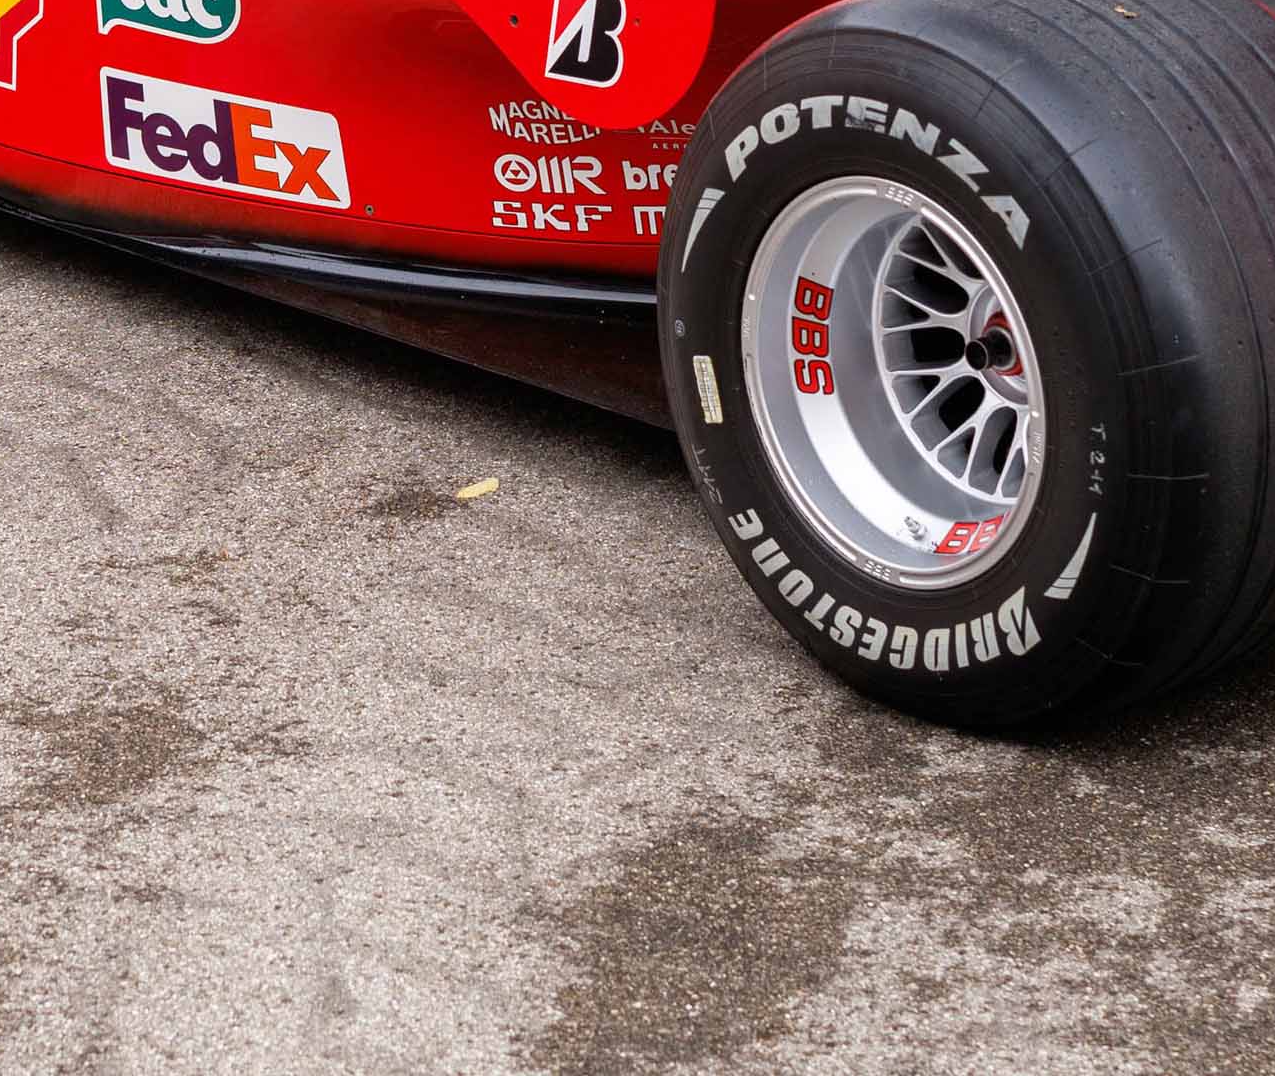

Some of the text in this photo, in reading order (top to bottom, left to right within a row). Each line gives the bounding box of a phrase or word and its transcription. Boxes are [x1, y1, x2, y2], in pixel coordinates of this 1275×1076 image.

[106, 76, 342, 202] FedEx
[724, 95, 1030, 251] POTENZA
[492, 200, 612, 232] SKF
[794, 276, 834, 396] BBS
[728, 508, 1041, 673] BRIDGESTONE
[934, 511, 1011, 555] BB
